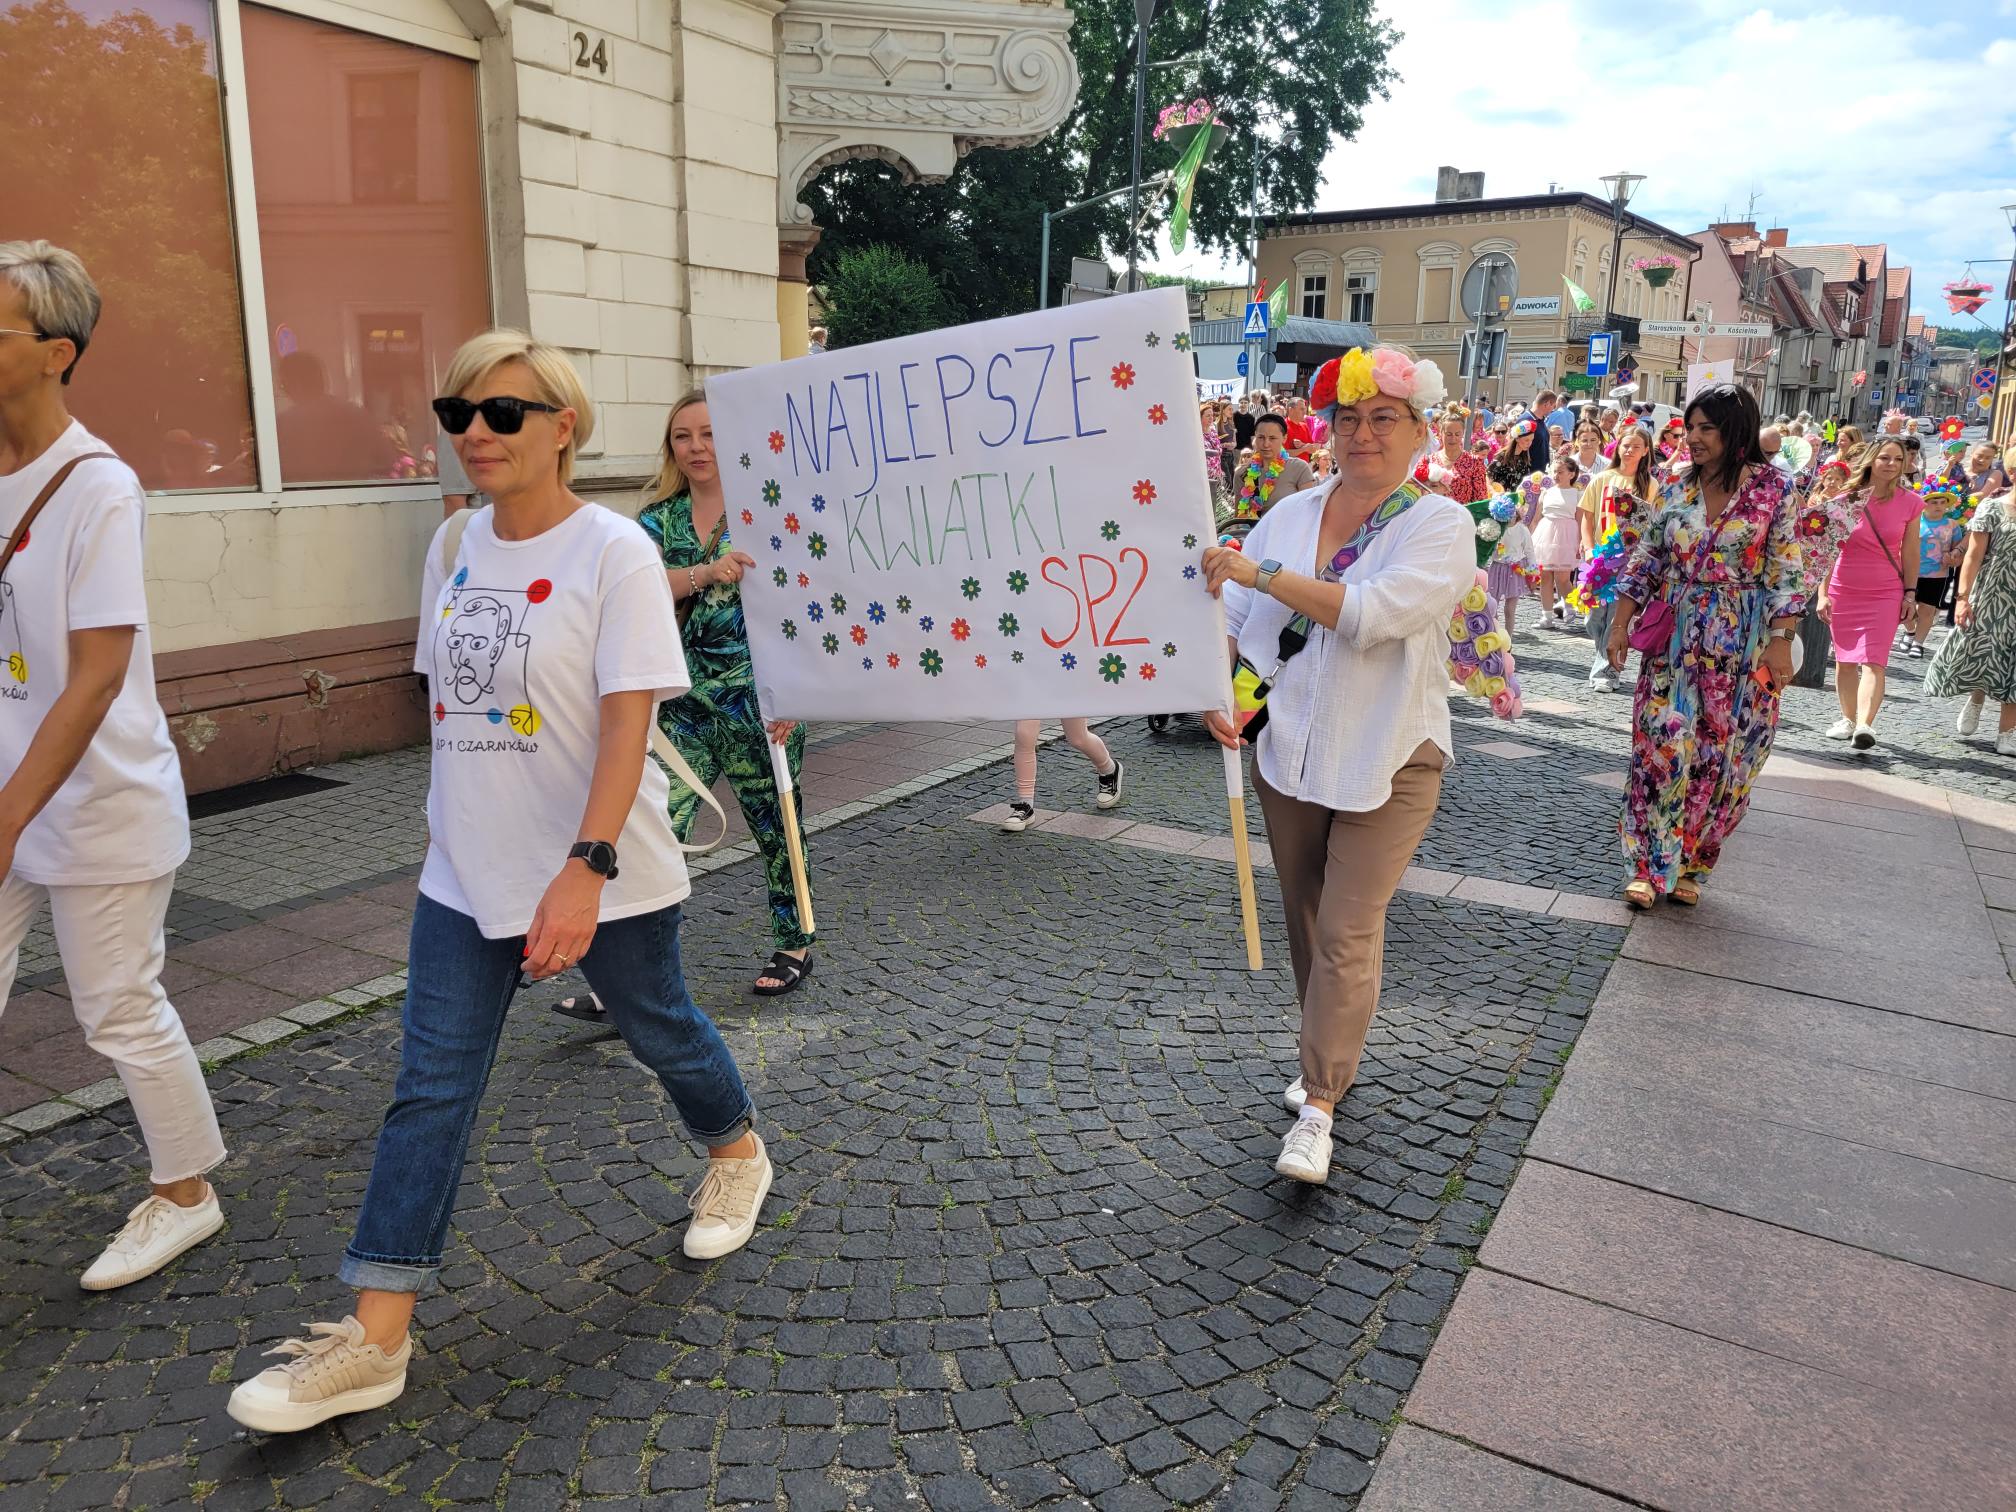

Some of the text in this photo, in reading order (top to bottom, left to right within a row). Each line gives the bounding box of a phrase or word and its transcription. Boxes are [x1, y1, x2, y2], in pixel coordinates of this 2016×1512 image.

[574, 32, 608, 74] 24
[1515, 302, 1558, 310] ADWOKAT
[1648, 324, 1686, 332] Staroszkolna
[1727, 326, 1758, 335] Kościelna
[786, 335, 1107, 499] NAJLEPSZE
[842, 465, 1066, 573] KWIATKI
[1040, 546, 1151, 650] SP2
[457, 738, 539, 753] CZARNKÓW
